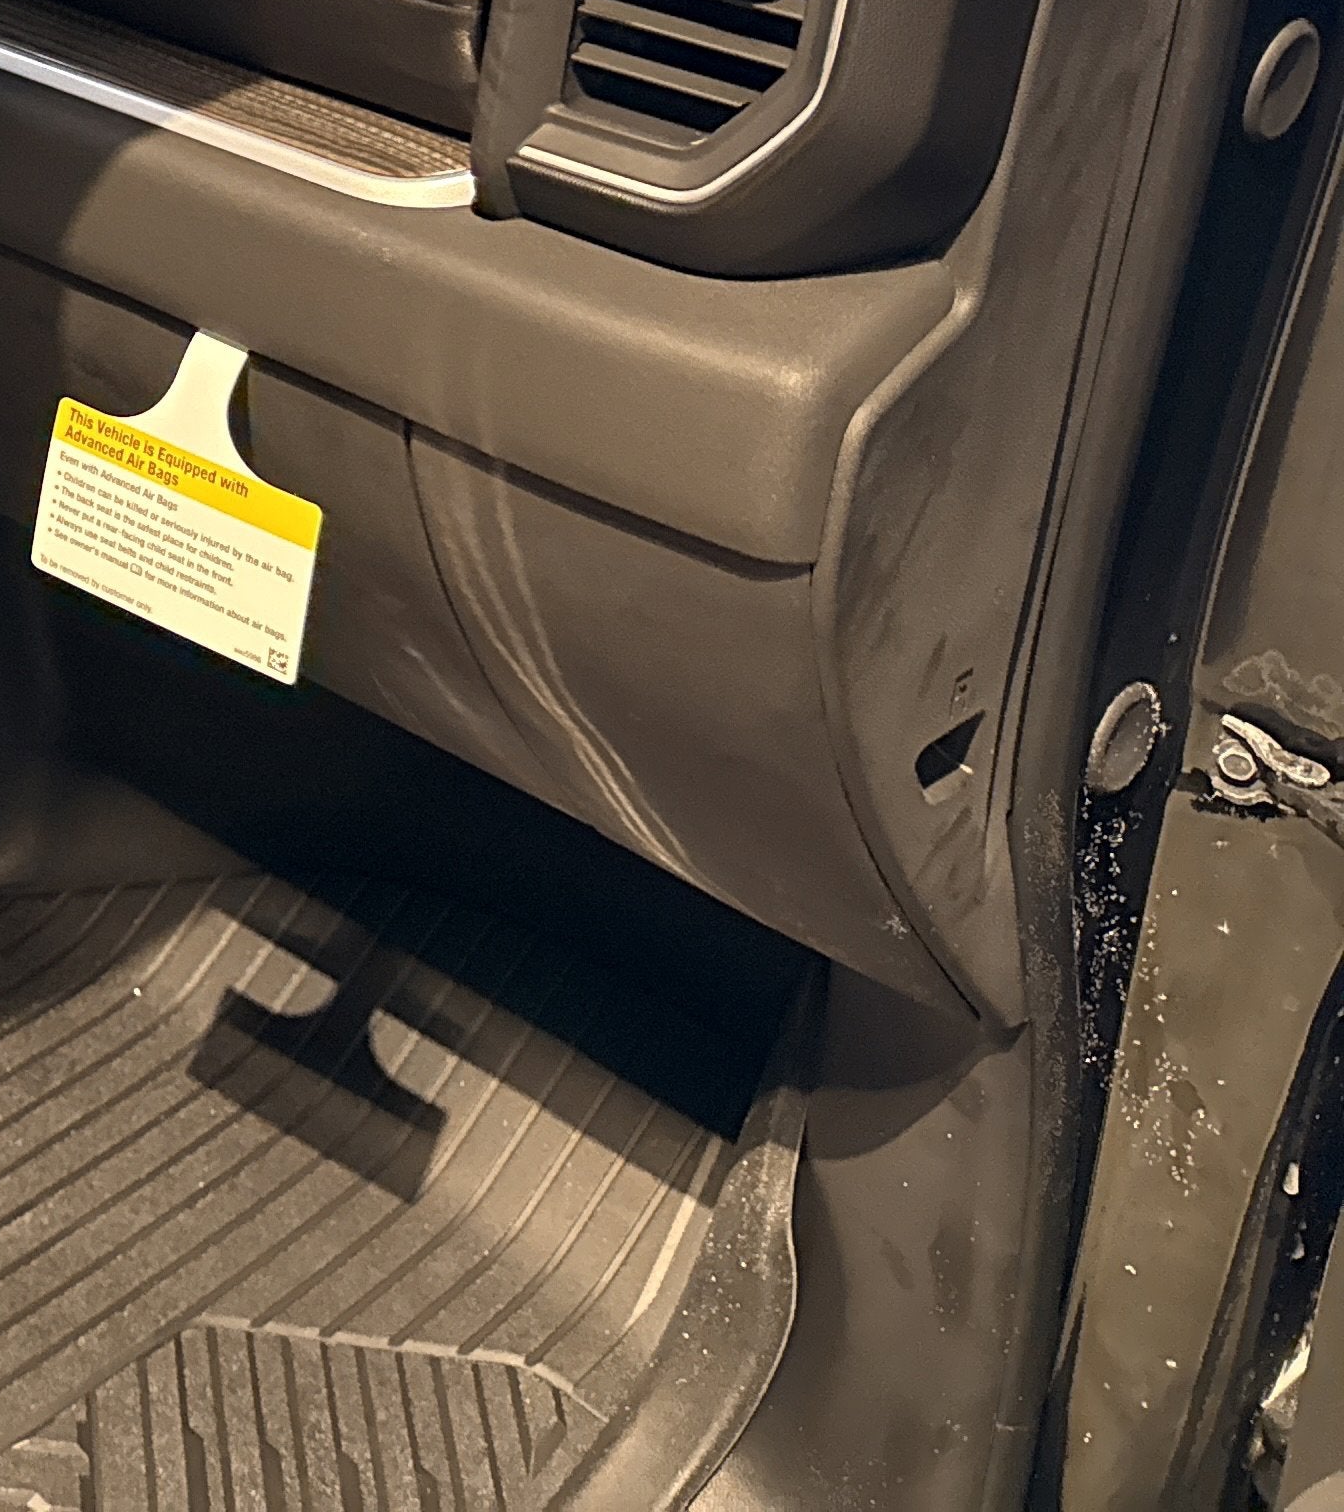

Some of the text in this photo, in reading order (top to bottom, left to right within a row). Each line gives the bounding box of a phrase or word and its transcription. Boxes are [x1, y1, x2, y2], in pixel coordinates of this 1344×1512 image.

[64, 425, 179, 486] Advanced Air Bags
[70, 407, 248, 498] This Vehicle is Equipped with
